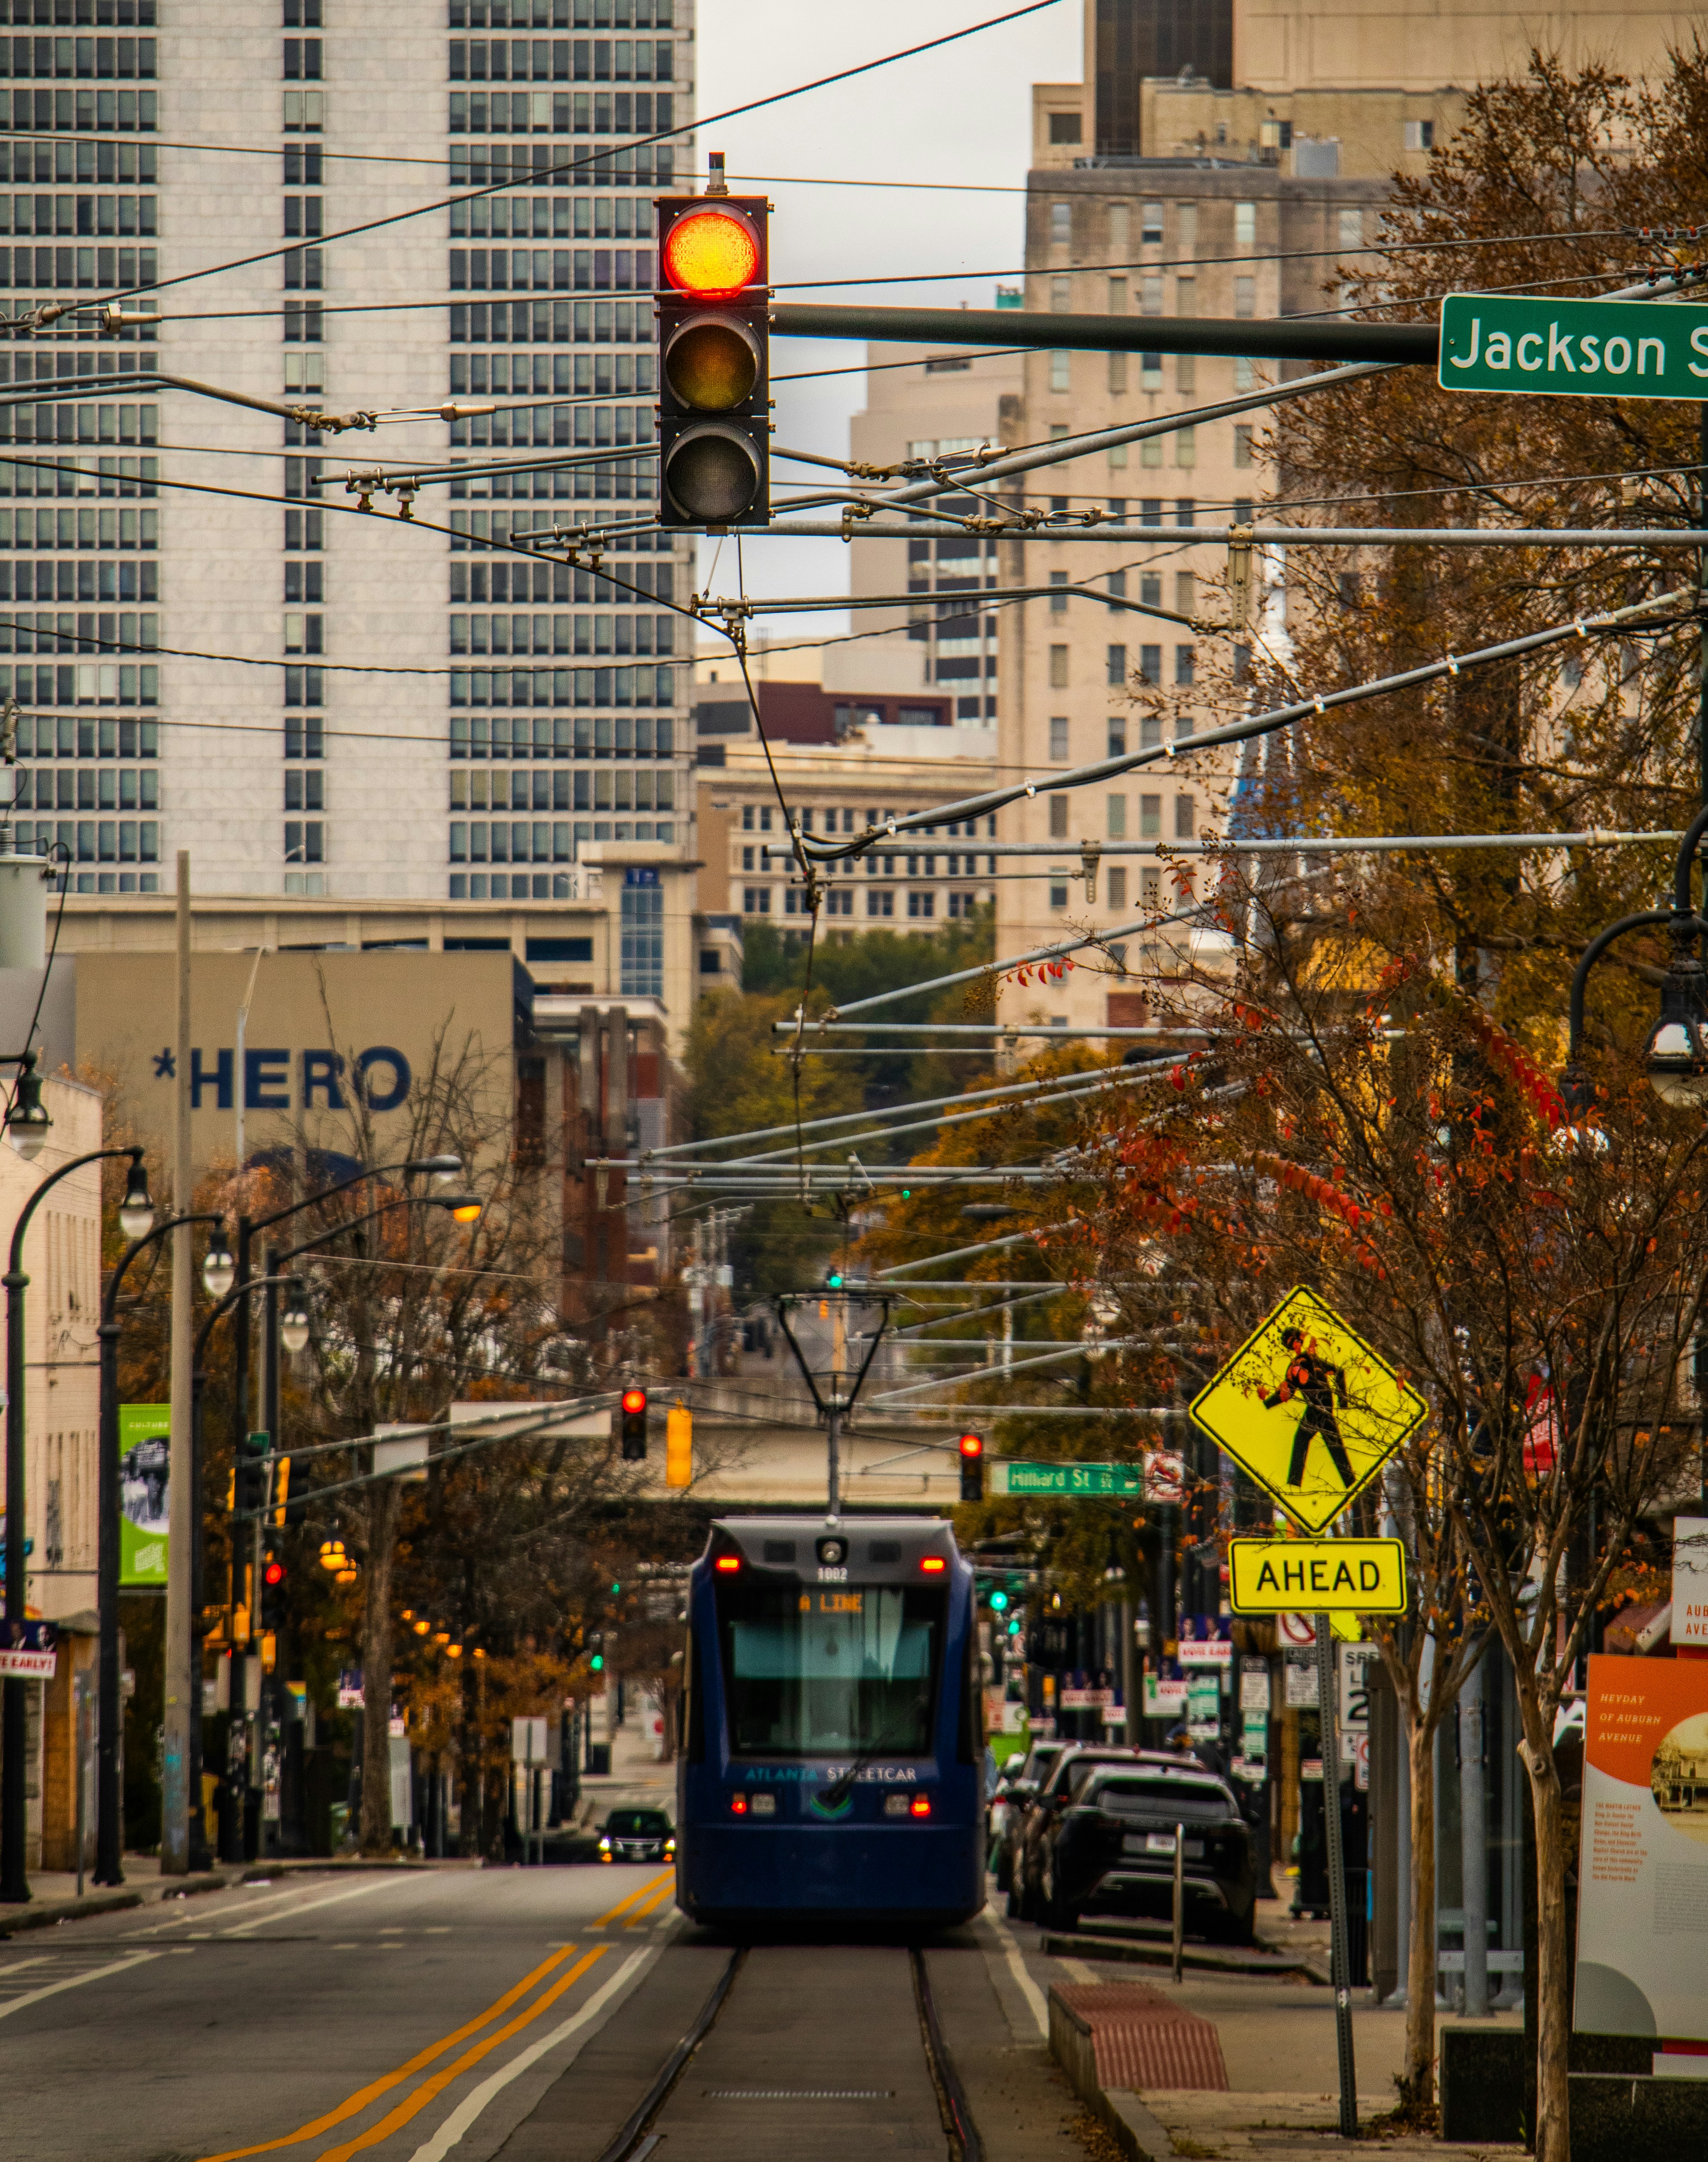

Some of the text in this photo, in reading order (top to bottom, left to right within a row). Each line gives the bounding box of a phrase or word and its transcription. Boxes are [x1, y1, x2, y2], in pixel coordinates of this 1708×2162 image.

[1450, 318, 1665, 375] Jackson
[818, 1567, 848, 1581] 1002
[1256, 1560, 1380, 1591] AHEAD
[1600, 1694, 1645, 1704] HEYDAY
[1599, 1713, 1661, 1724] OF AUBURN
[1598, 1732, 1642, 1743] AVENUE
[745, 1767, 917, 1782] ATLANTA STEETCAR
